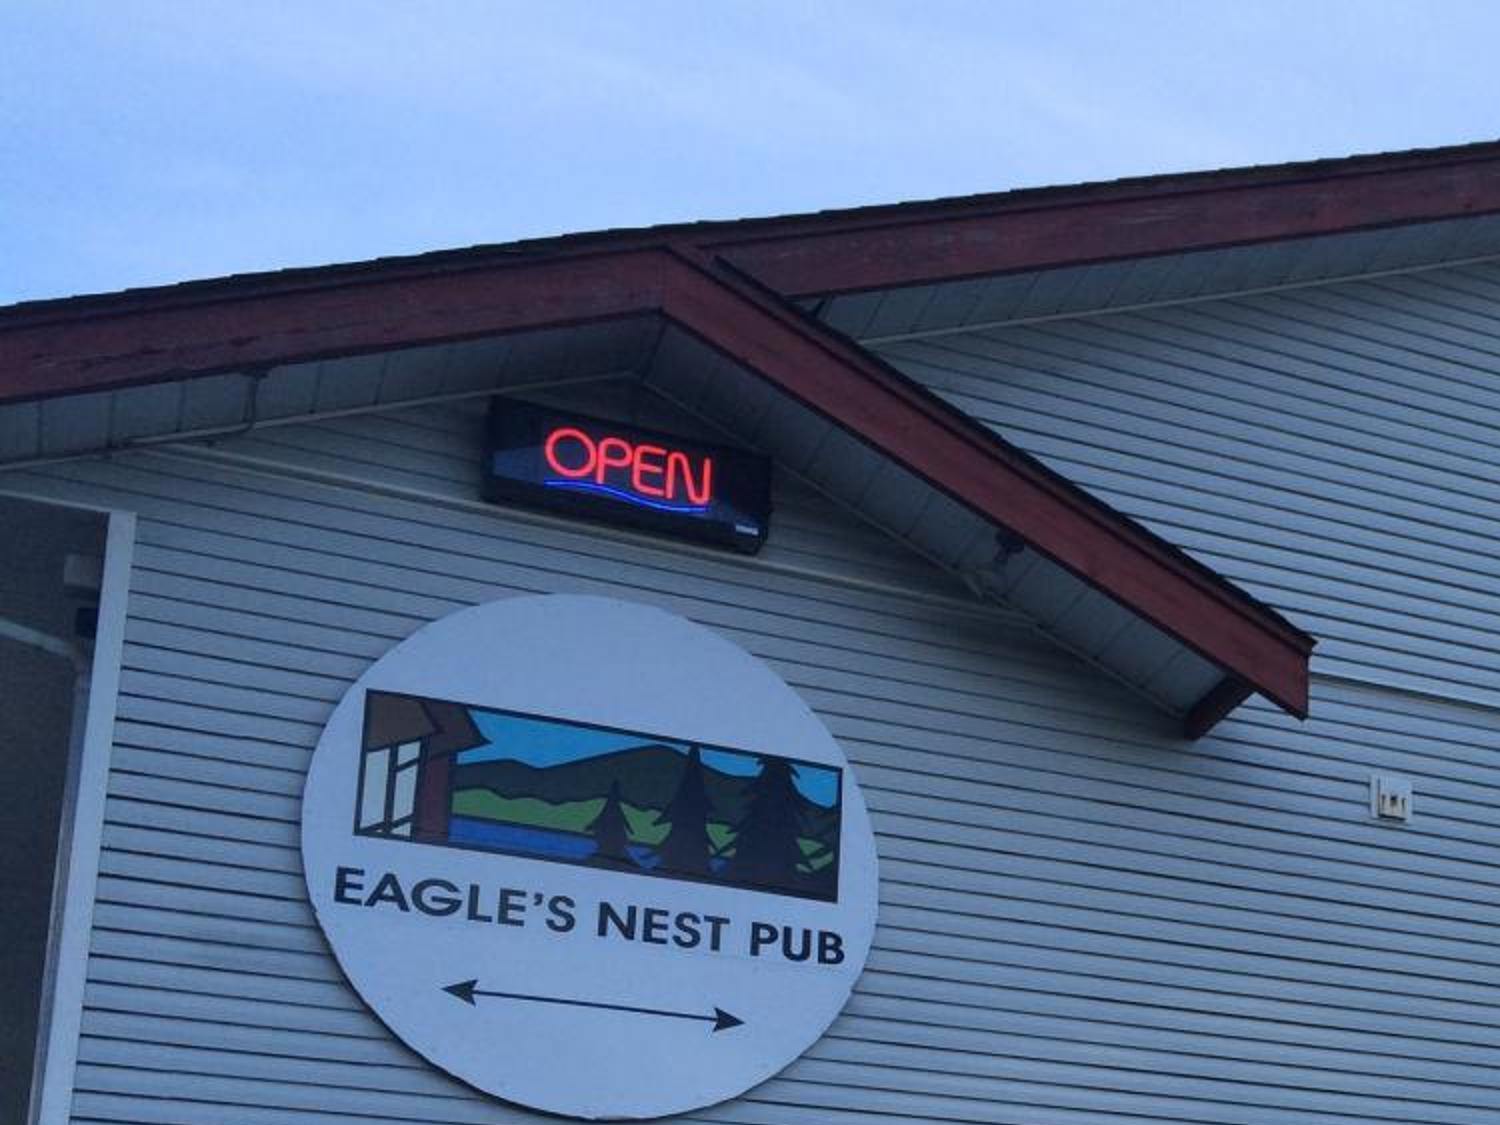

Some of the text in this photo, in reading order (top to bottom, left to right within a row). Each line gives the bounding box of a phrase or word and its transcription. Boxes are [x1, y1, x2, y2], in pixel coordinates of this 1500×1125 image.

[544, 427, 712, 505] OPEN
[333, 865, 846, 966] EAGLE'S NEST PUB
